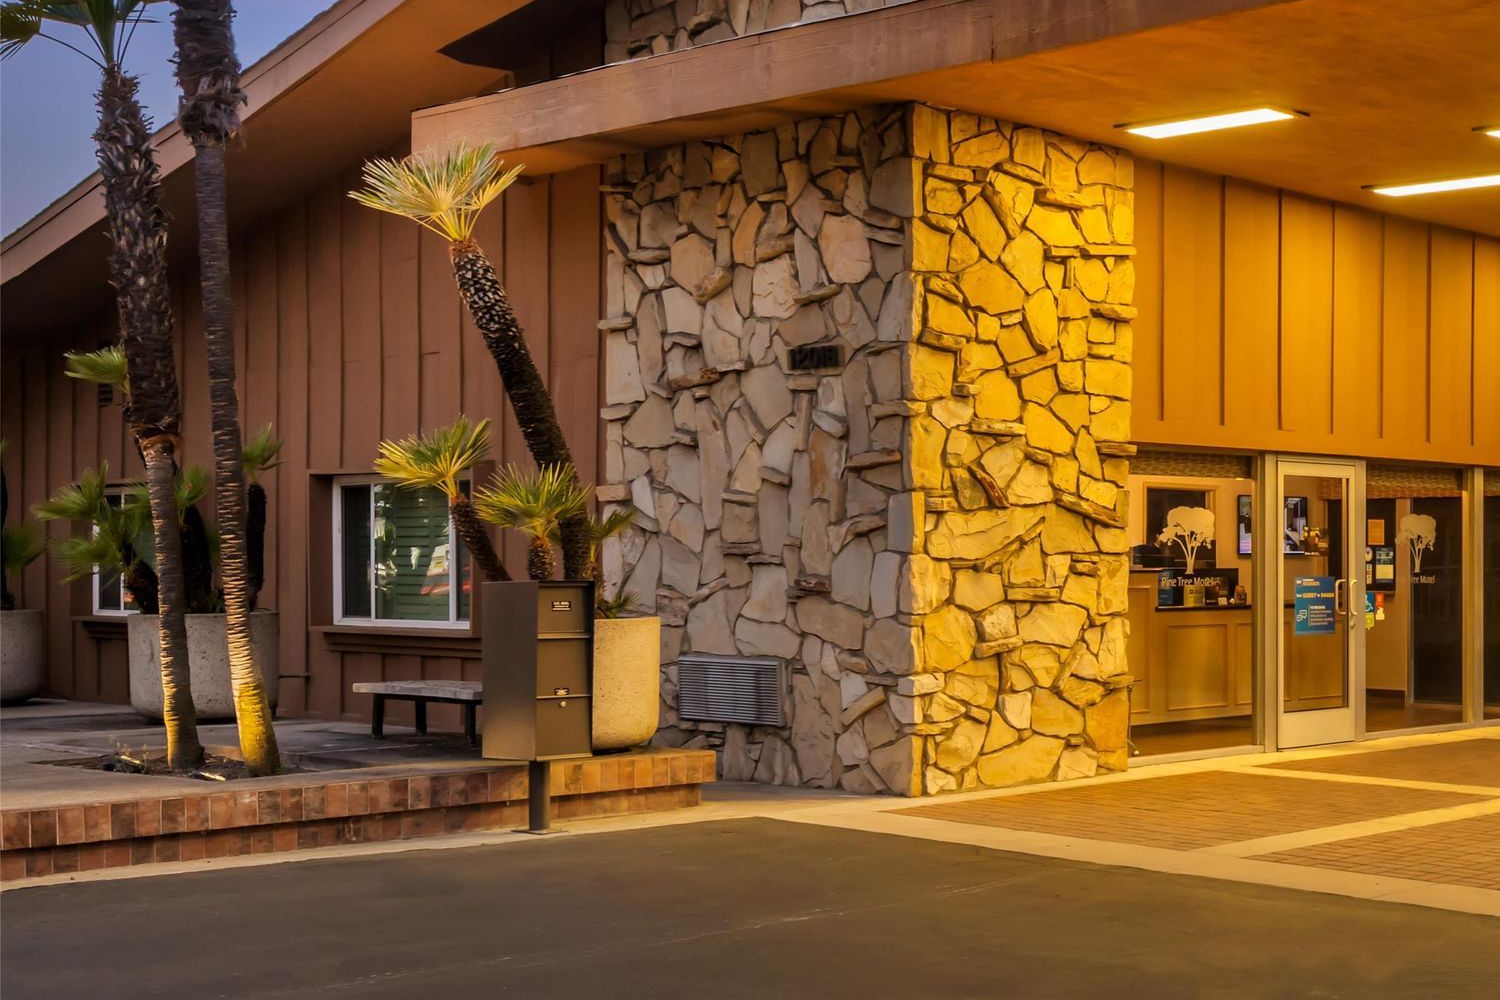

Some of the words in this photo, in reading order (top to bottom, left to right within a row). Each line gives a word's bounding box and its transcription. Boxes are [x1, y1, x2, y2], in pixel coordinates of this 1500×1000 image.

[1161, 577, 1176, 587] Pine
[1177, 577, 1193, 587] Tree
[1420, 575, 1436, 584] Motel
